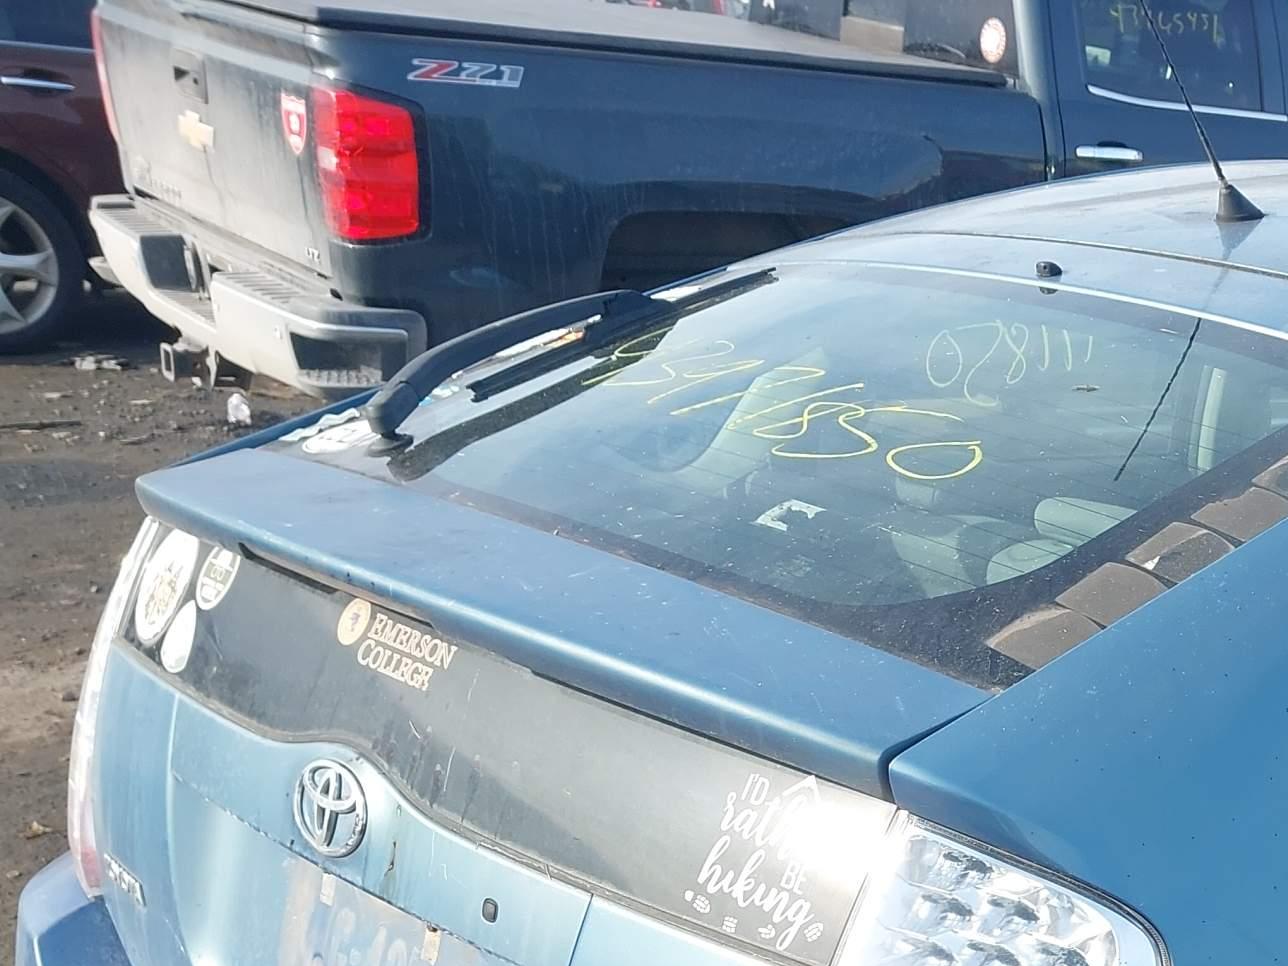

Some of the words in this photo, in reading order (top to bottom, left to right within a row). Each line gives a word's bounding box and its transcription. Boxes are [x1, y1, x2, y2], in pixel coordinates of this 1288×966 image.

[406, 58, 524, 88] Z71
[357, 638, 434, 692] COLLEGE
[367, 612, 459, 670] EMERSON
[697, 834, 815, 951] hiking
[780, 861, 807, 896] BE
